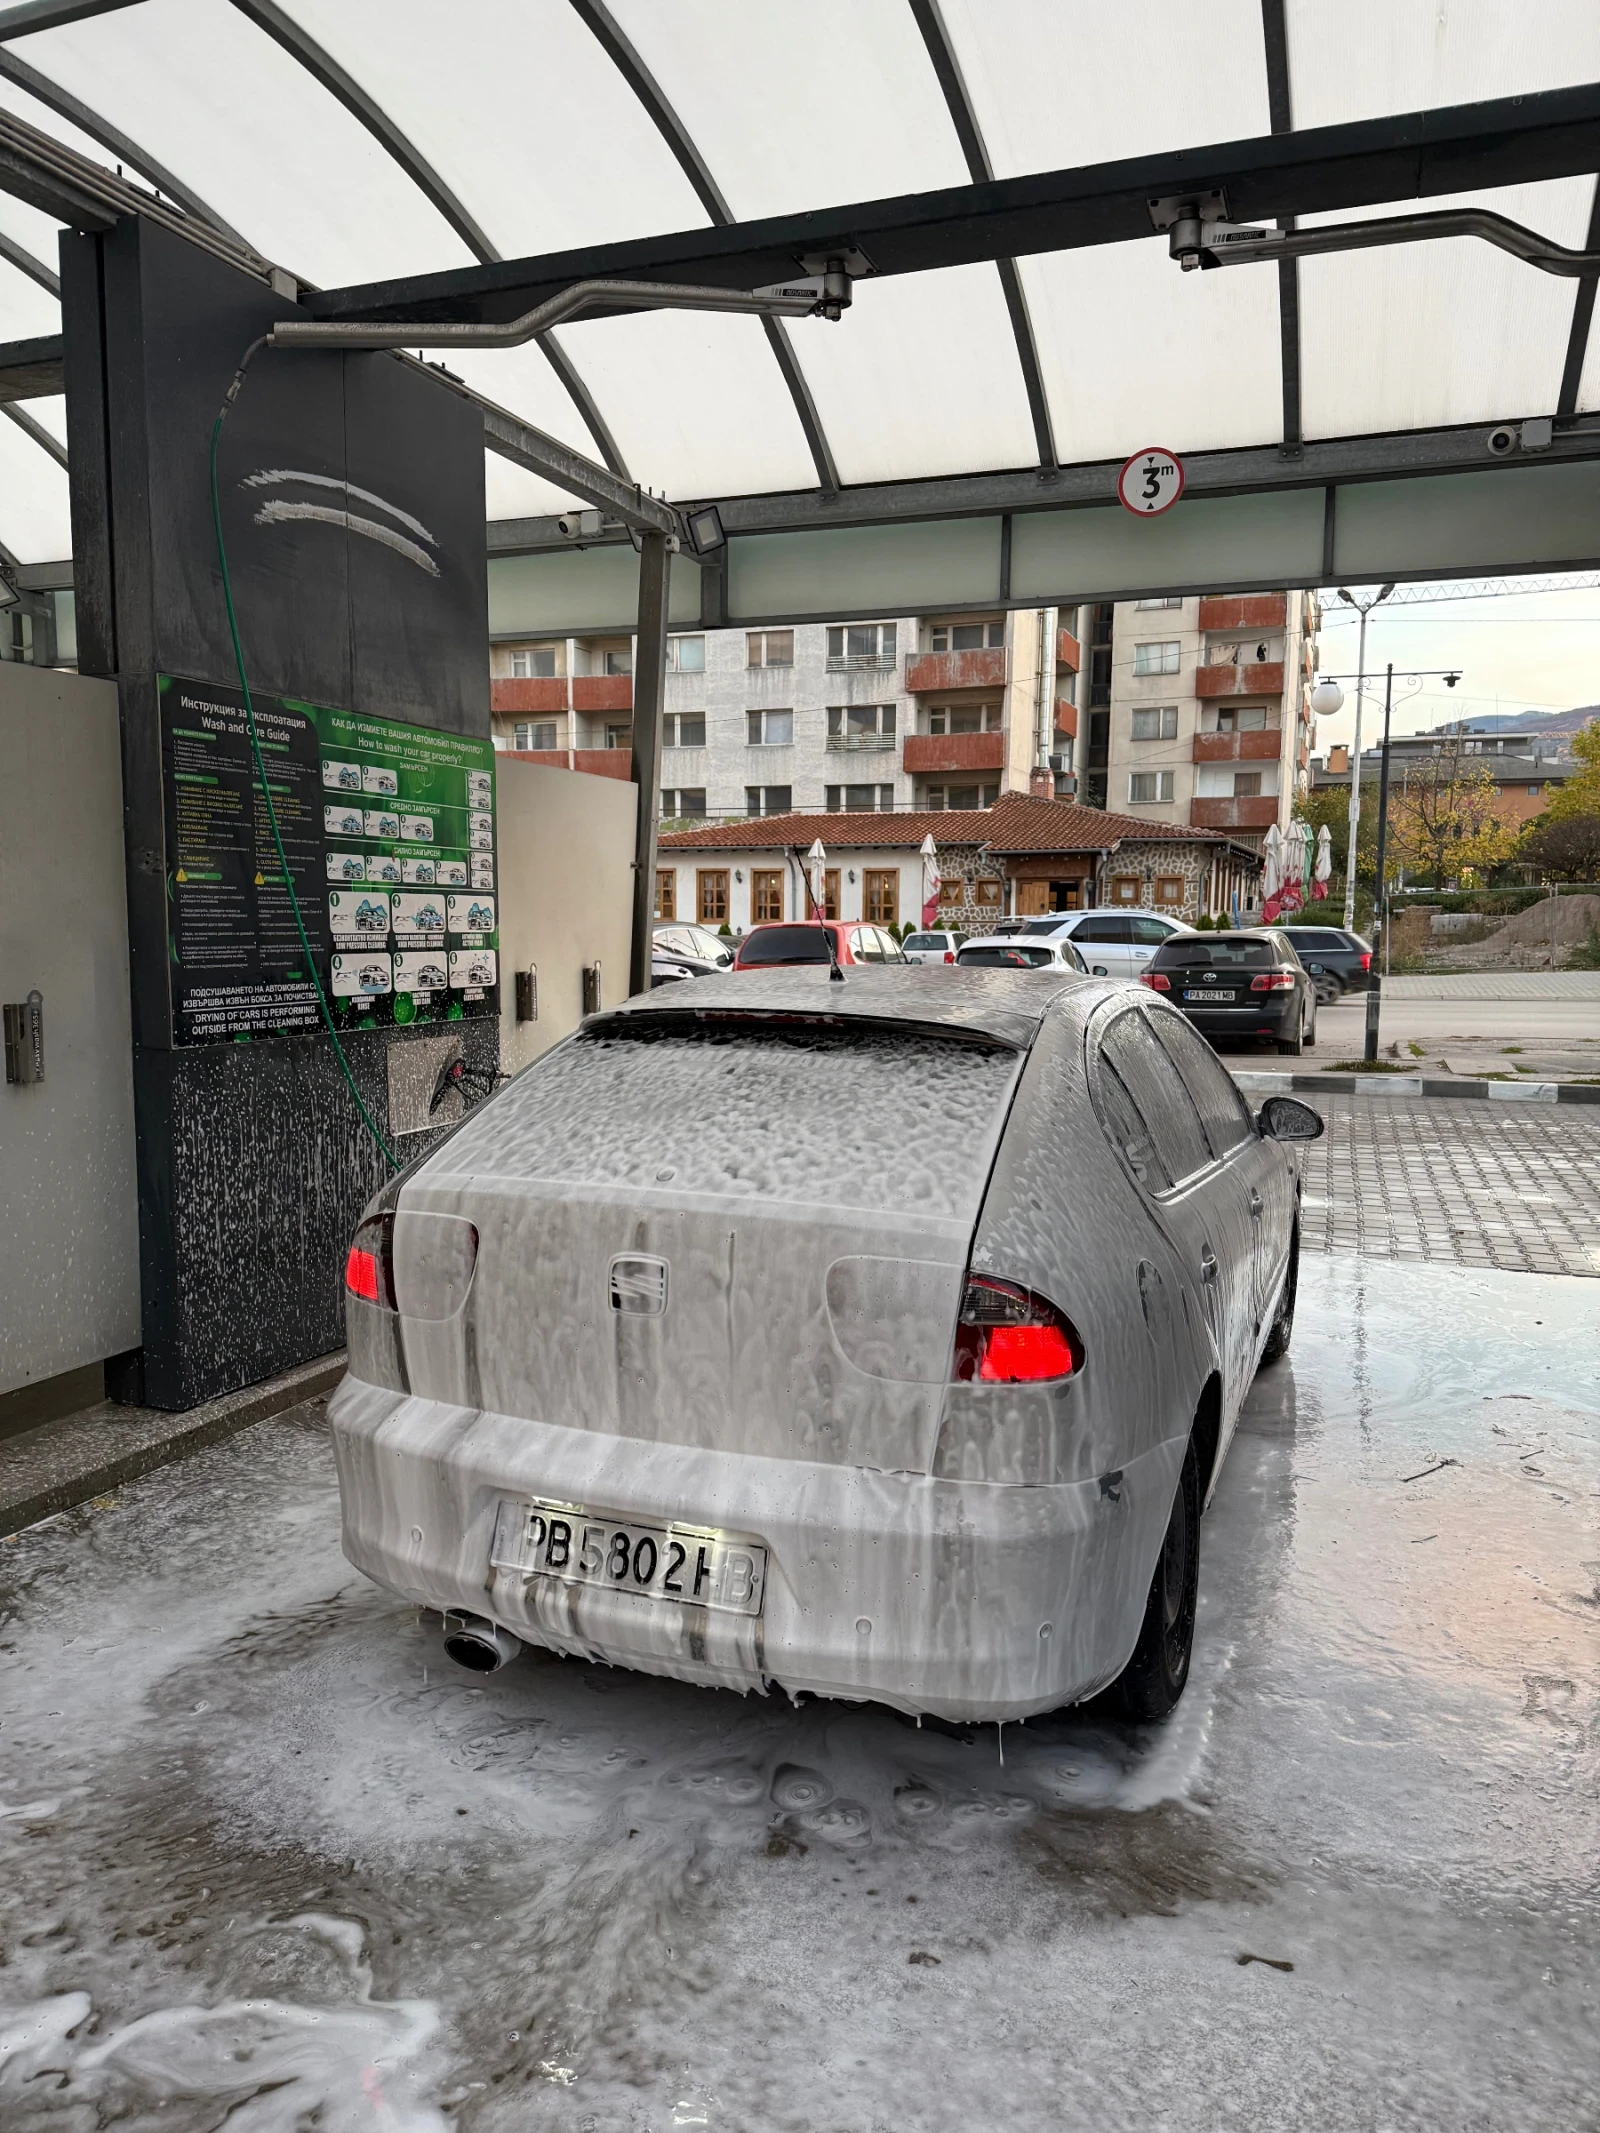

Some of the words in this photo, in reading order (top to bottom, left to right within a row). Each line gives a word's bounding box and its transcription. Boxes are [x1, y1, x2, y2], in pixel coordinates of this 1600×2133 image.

[180, 695, 236, 717] Инструкция
[238, 708, 248, 718] за
[202, 716, 227, 731] Wash
[228, 722, 244, 734] and
[246, 724, 265, 738] Cre
[266, 728, 290, 742] Guide
[331, 718, 346, 729] КАК
[346, 720, 357, 731] ДА
[358, 722, 388, 736] ИЗМИЕТЕ
[388, 728, 412, 741] ВАШИЯ
[412, 732, 450, 748] АВТОМОБИЛ
[358, 736, 375, 748] How
[376, 741, 383, 750] to
[384, 741, 402, 754] wash
[403, 747, 419, 759] your
[420, 748, 431, 759] car
[432, 750, 462, 766] properly?
[399, 762, 429, 774] ЗАМЪРСЕН
[390, 802, 412, 812] СРЕДНО
[413, 804, 440, 815] ЗАМЪРСЕН
[393, 846, 412, 855] СИЛНО
[412, 848, 440, 857] ЗАМЪРСЕН
[333, 894, 337, 906] 1
[394, 896, 399, 906] 2
[334, 956, 340, 968] 4
[396, 954, 401, 966] 5
[452, 953, 456, 963] 6
[190, 986, 254, 998] ПОДСУШАВАНЕТО
[254, 985, 265, 994] НА
[265, 982, 308, 993] АВТОМОБИЛИ
[1190, 991, 1200, 999] PA
[1202, 991, 1220, 1000] 2021
[1222, 991, 1233, 1000] MB
[182, 997, 225, 1008] ИЗВЪРШВА
[226, 996, 250, 1005] ИЗВЪН
[251, 994, 273, 1004] БОКСА
[273, 993, 283, 1002] ЗА
[195, 1012, 225, 1023] DRYING
[227, 1011, 238, 1021] OF
[240, 1009, 260, 1019] CARS
[261, 1009, 269, 1018] IS
[270, 1006, 316, 1017] PERFORMING
[192, 1023, 227, 1035] OUTSIDE
[228, 1022, 251, 1032] FROM
[252, 1020, 266, 1029] THE
[267, 1017, 303, 1028] CLEANING
[304, 1016, 320, 1025] BOX
[579, 1523, 687, 1593] 5802
